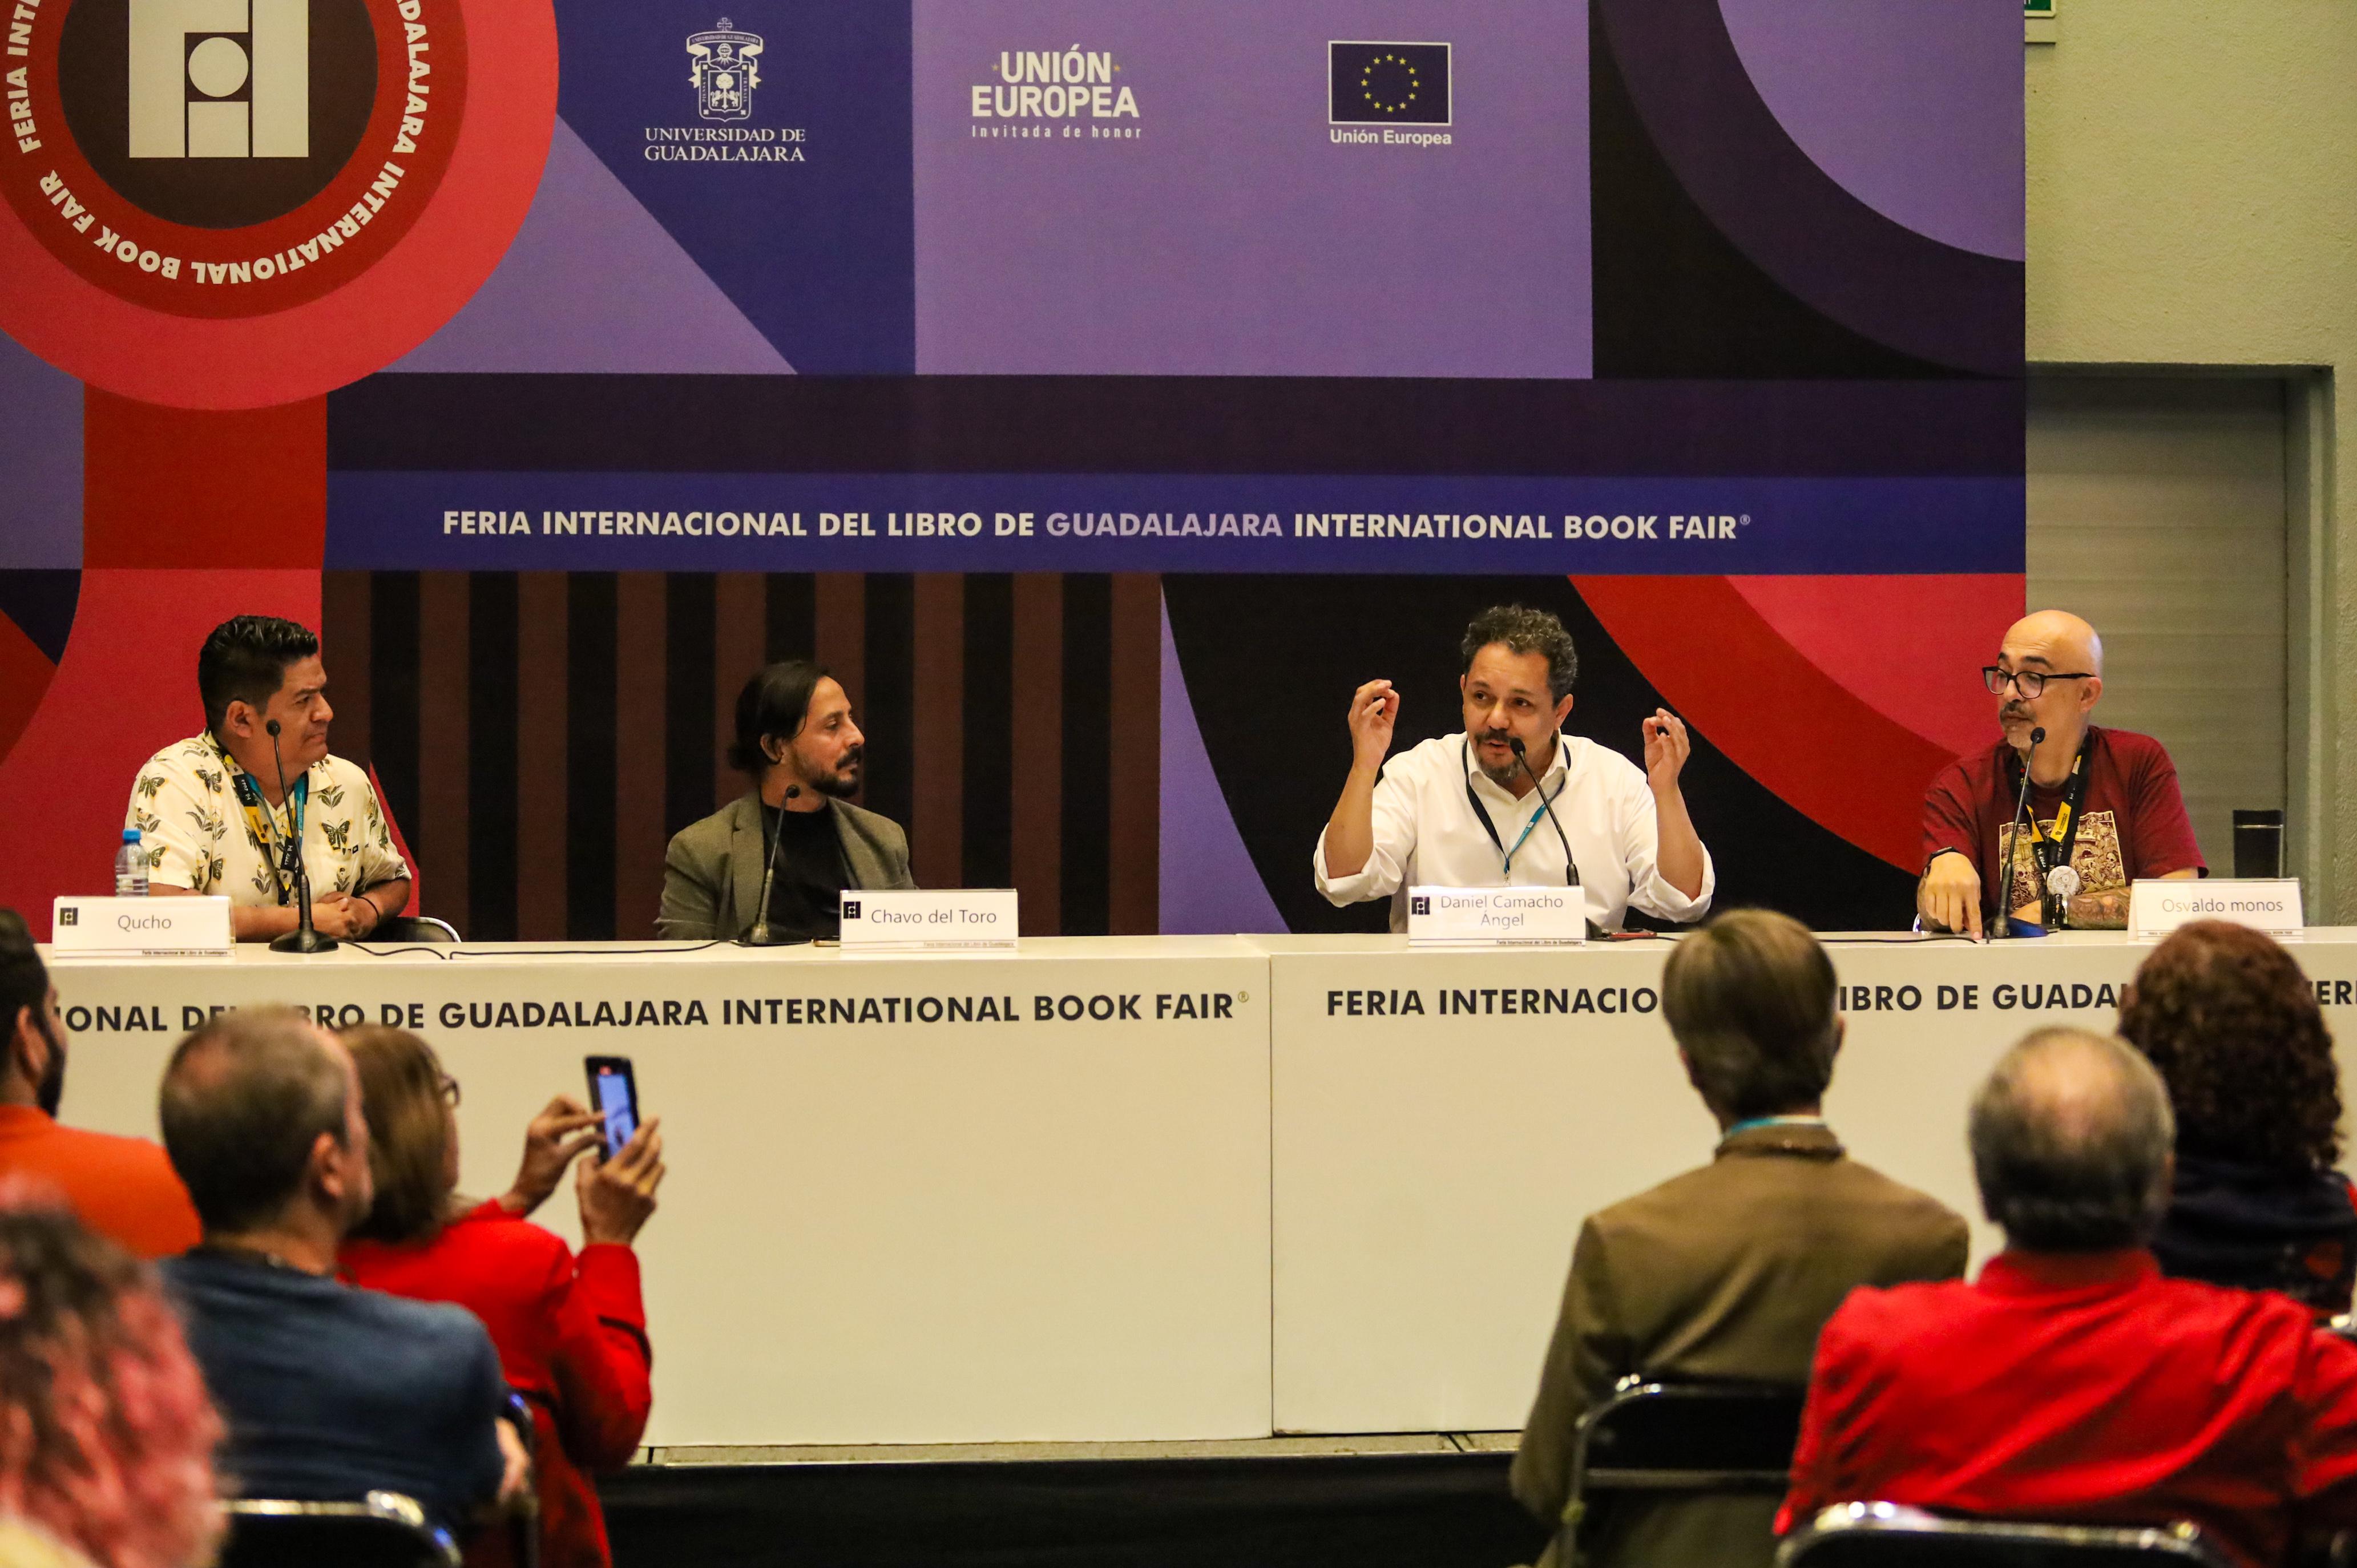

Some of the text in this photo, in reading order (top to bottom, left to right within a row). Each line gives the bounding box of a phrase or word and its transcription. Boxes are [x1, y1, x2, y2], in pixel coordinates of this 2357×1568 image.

[1001, 43, 1111, 83] UNIÓN
[6, 66, 42, 153] FERIA
[972, 85, 1140, 118] EUROPEA
[645, 128, 805, 142] UNIVERSIDAD DE
[972, 124, 1141, 138] Invitada de honor
[1330, 128, 1452, 148] Unión Europea
[40, 0, 430, 284] DALAJARA INTERNATIONAL BOOK FAIR
[644, 145, 805, 161] GUADALAJARA
[443, 511, 531, 535] FERIA
[543, 511, 807, 536] INTERNACIONAL
[819, 512, 876, 536] DEL
[888, 512, 982, 536] LIBRO
[995, 512, 1034, 536] DE
[1046, 512, 1283, 537] GUADALAJARA
[1295, 514, 1552, 539] INTERNATIONAL
[1564, 515, 1658, 539] BOOK
[1441, 895, 1563, 908] Daniel Camacho
[2162, 898, 2283, 912] Osvaldo monos
[118, 915, 172, 932] Qucho
[871, 909, 996, 923] Chavo del Toro
[1481, 910, 1524, 930] Ángel
[1328, 984, 2128, 1016] FERIA INTERNACIO IBRO DE GUADA
[381, 1003, 424, 1029] DE
[439, 1000, 709, 1028] GUADALAJARA
[723, 996, 1019, 1025] INTERNATIONAL
[1035, 995, 1141, 1021] BOOK
